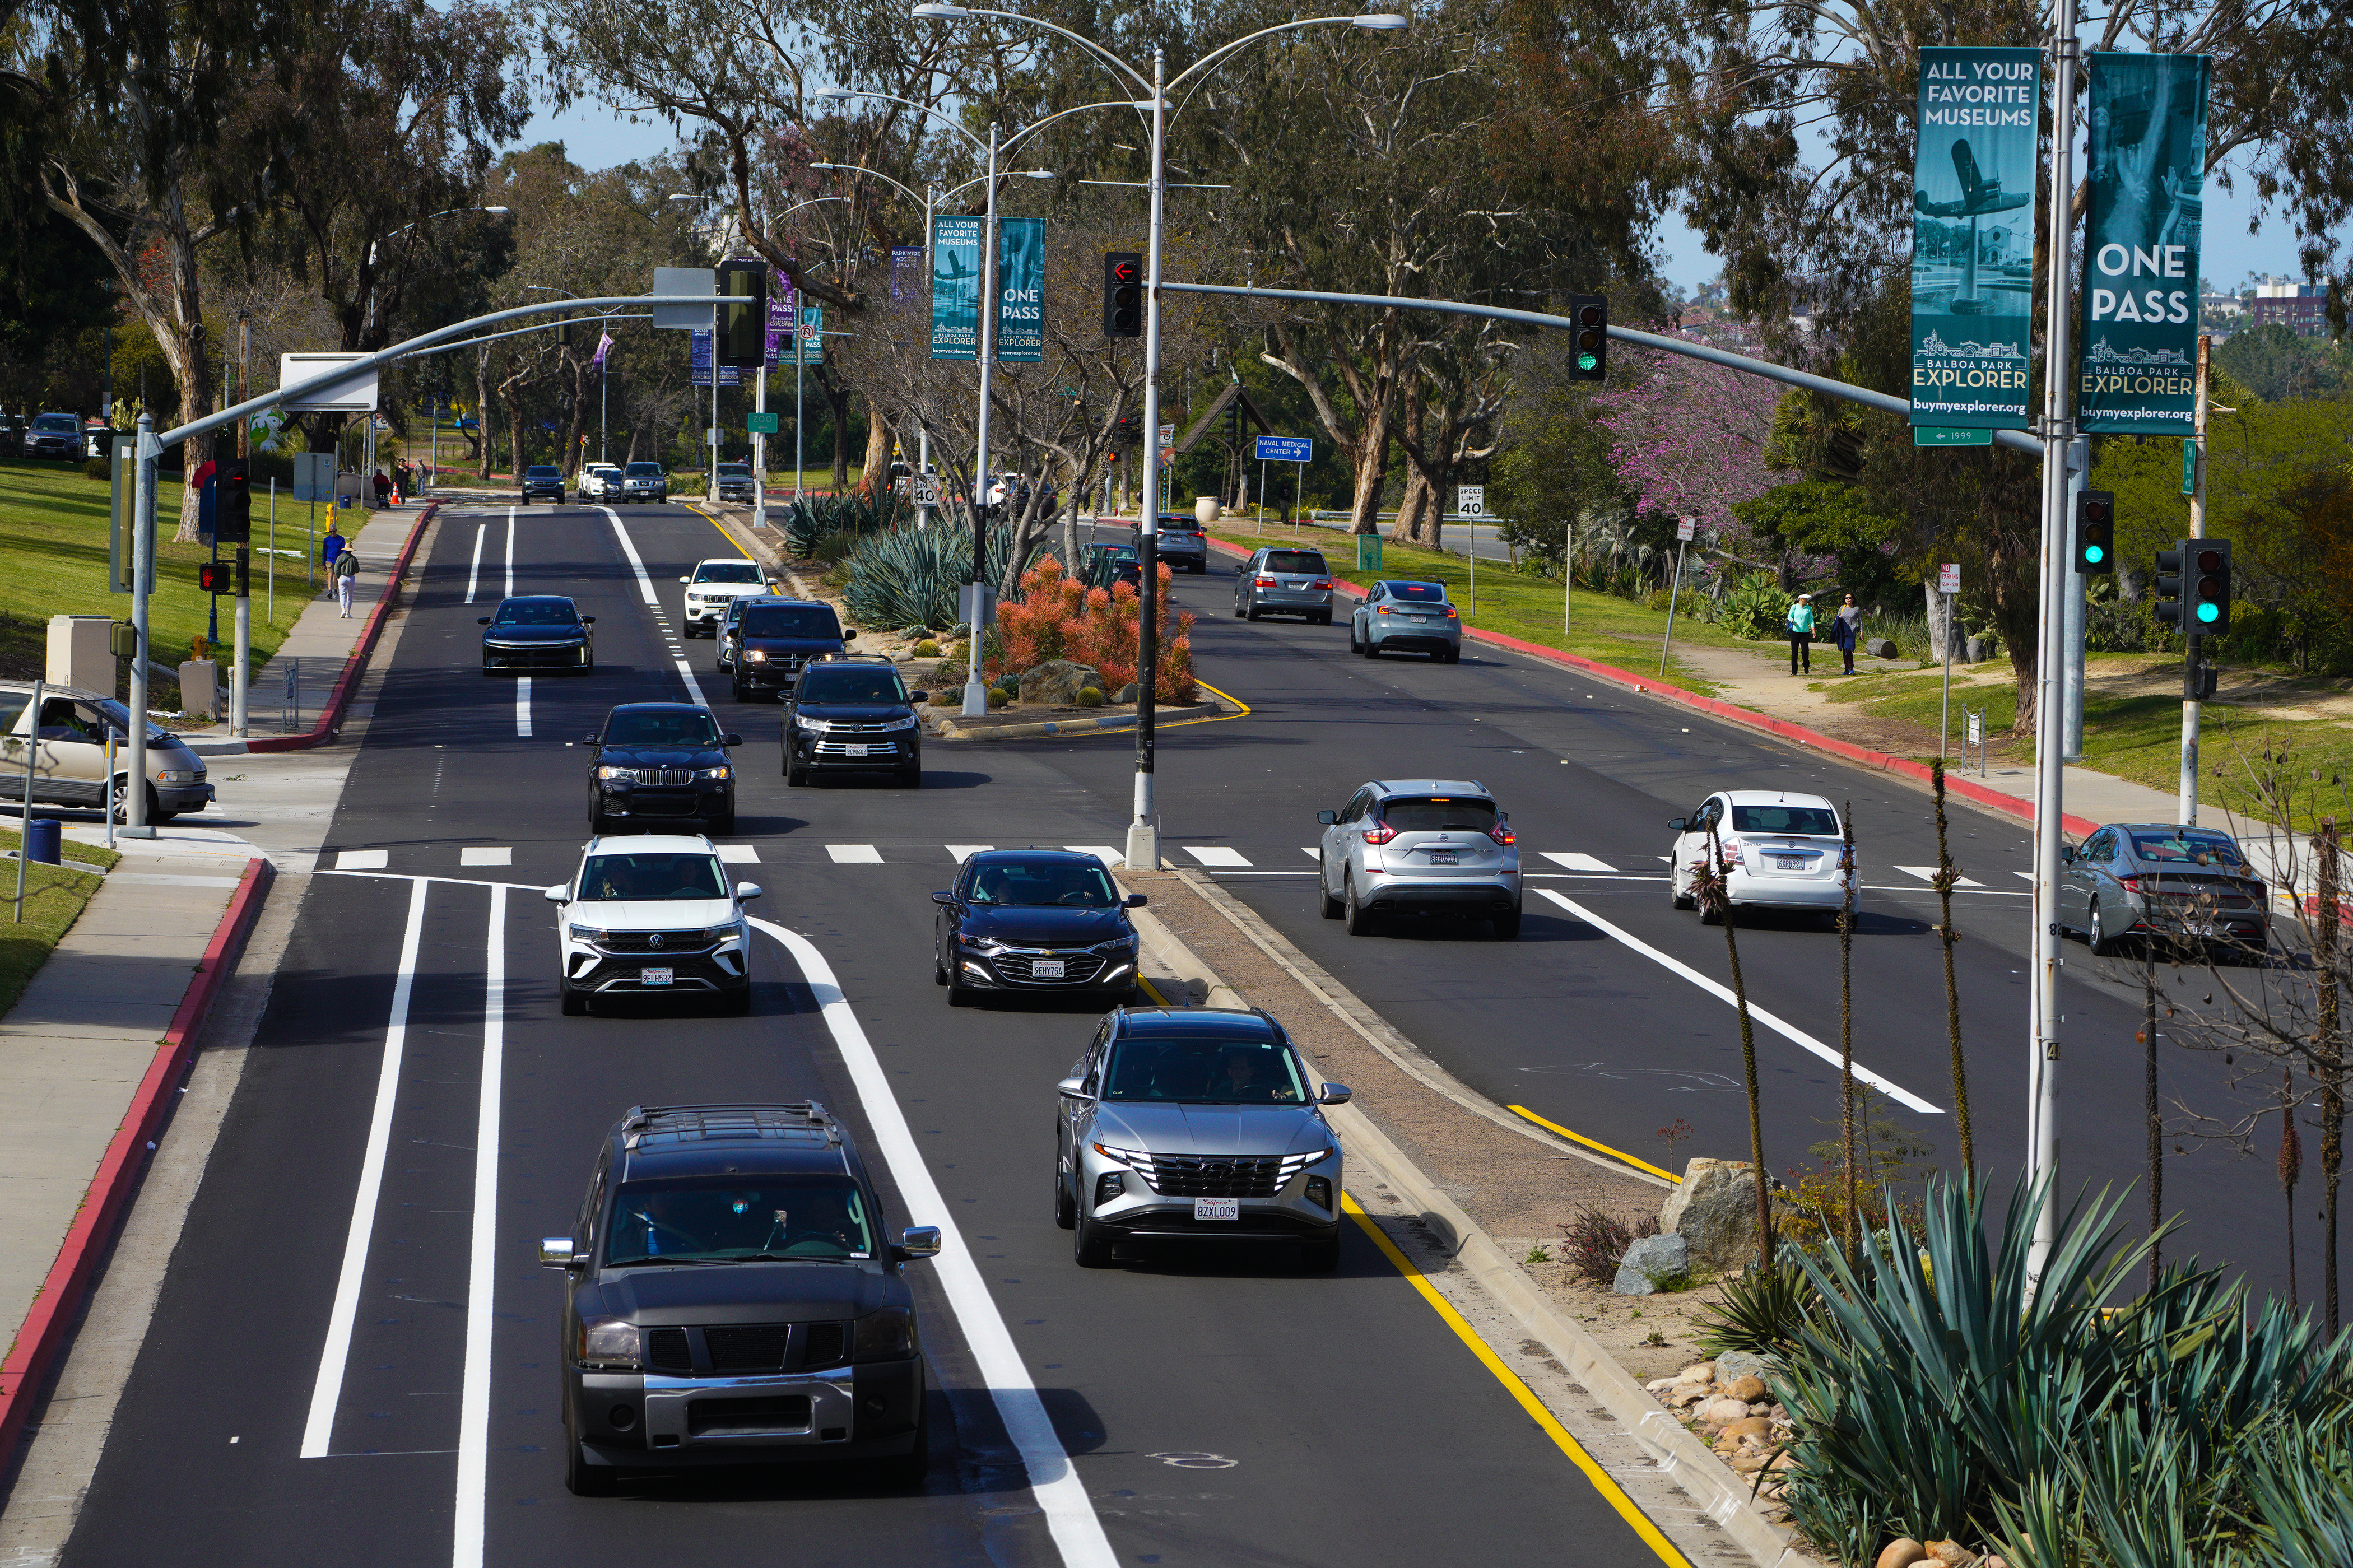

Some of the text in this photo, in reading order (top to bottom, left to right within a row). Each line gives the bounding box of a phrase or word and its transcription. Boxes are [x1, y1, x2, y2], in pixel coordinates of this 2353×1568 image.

[1927, 63, 2033, 80] ALL YOUR
[1928, 85, 2030, 104] FAVORITE
[1925, 108, 2031, 127] MUSEUMS
[2097, 243, 2186, 278] ONE
[1004, 289, 1038, 303] ONE
[771, 304, 793, 313] PASS
[1002, 306, 1040, 320] PASS
[2092, 289, 2189, 324] PASS
[933, 337, 976, 345] EXPLORER
[998, 338, 1041, 347] EXPLORER
[1927, 359, 2012, 370] BALBOA PARK
[2095, 366, 2179, 376] BALBOA PARK
[1914, 369, 2026, 389] EXPLORER
[2082, 375, 2192, 395] EXPLORER
[1914, 399, 2026, 416] buymyexplorer.org
[2081, 405, 2192, 422] buymyexplorer.org
[916, 490, 934, 502] 40
[1461, 502, 1481, 514] 40
[643, 974, 671, 983] 9ELH532
[1198, 1206, 1236, 1217] 8ZXL009
